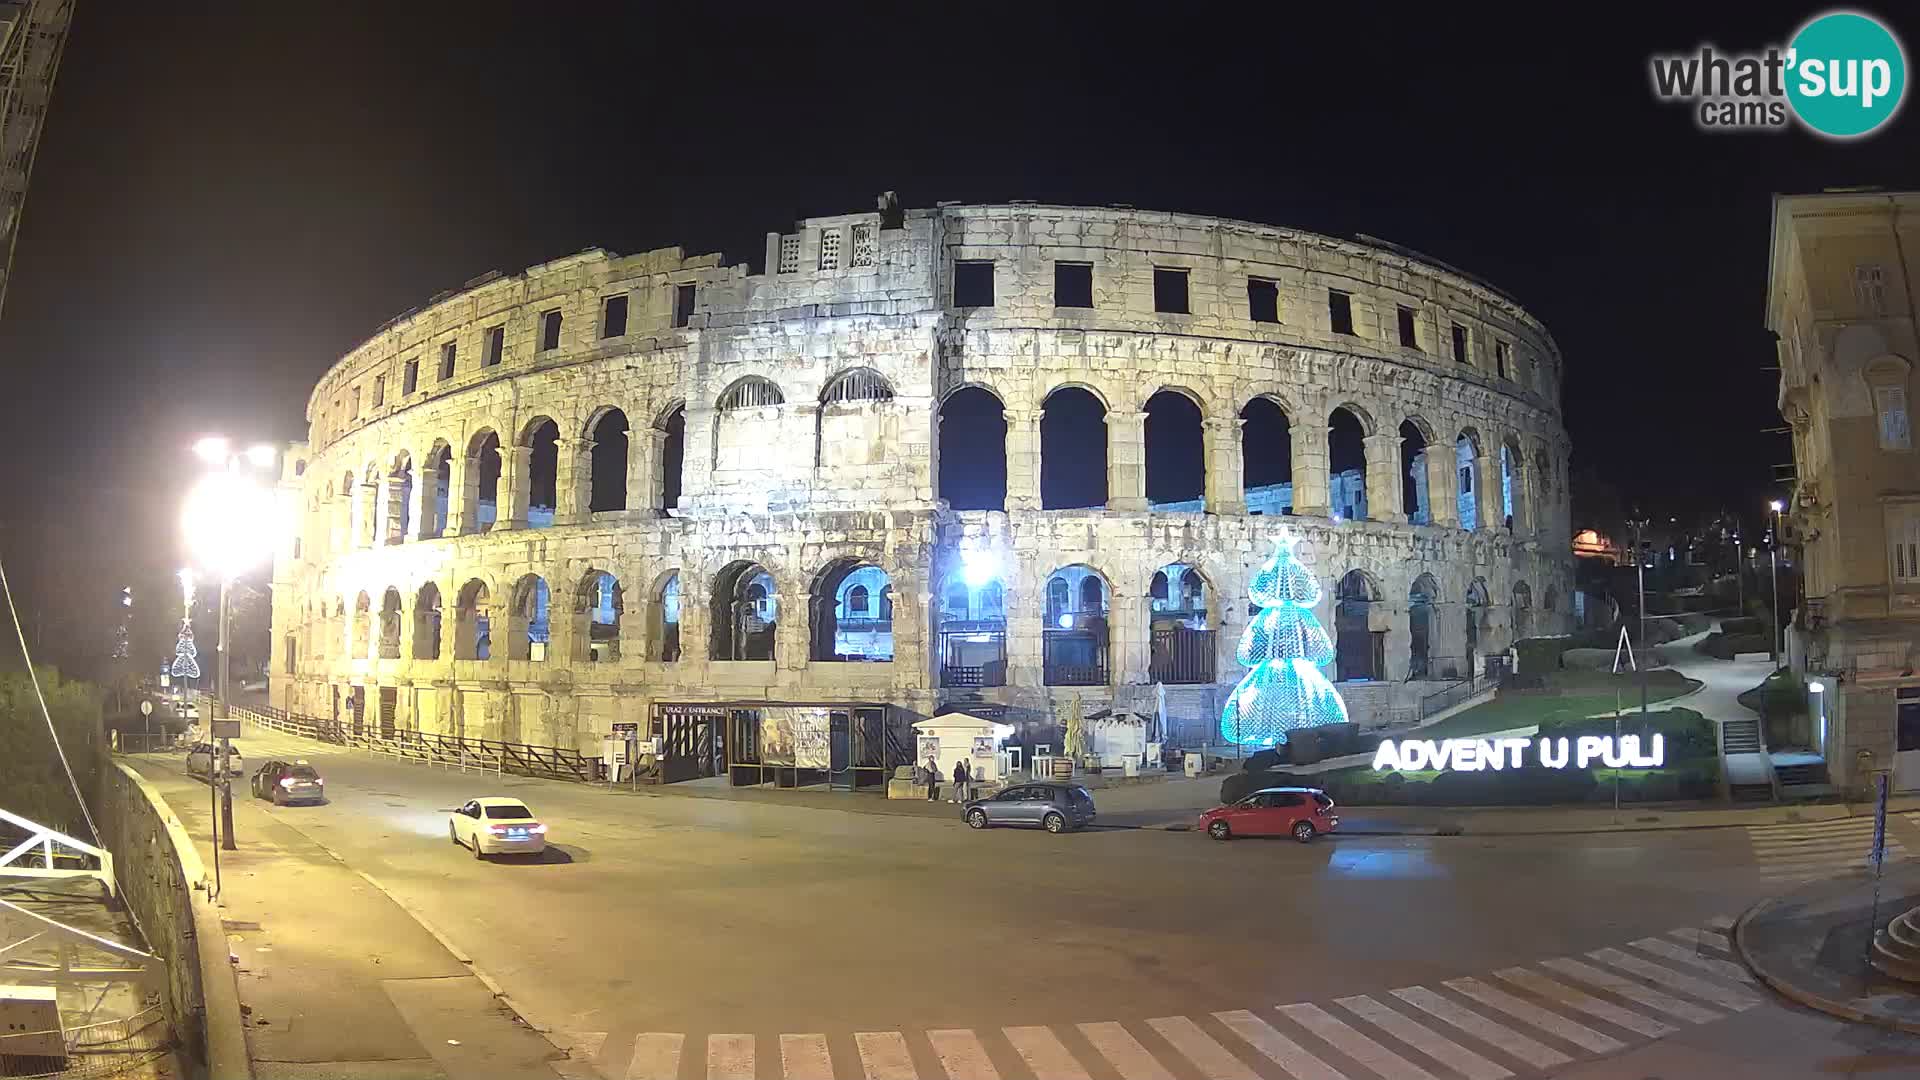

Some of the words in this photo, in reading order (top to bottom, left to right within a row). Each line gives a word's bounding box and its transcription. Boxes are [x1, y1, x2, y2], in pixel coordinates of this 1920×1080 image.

[689, 706, 724, 715] ENTRANCE
[1372, 738, 1531, 772] ADVENT
[1539, 736, 1570, 769] U
[1576, 733, 1665, 768] PULI
